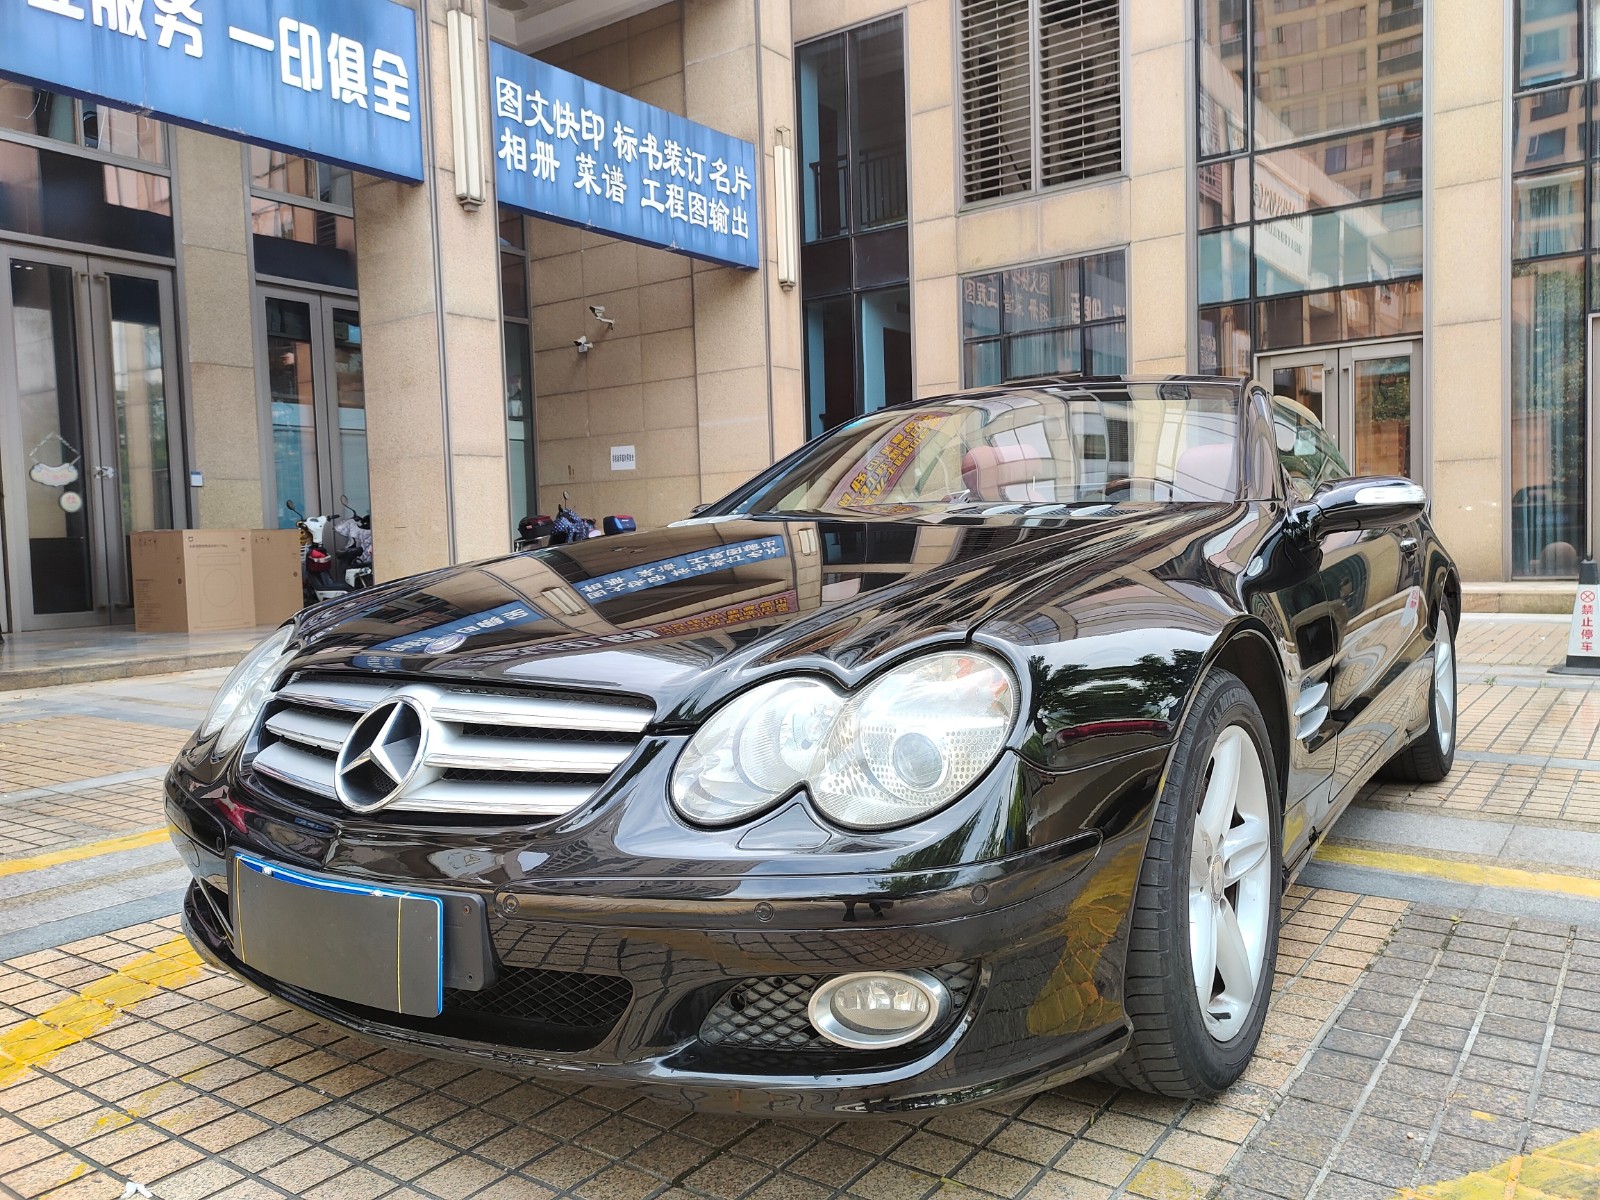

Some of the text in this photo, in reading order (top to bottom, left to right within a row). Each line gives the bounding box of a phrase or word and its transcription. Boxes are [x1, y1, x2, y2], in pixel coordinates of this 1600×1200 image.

[228, 16, 411, 122] 一印俱全
[495, 76, 752, 200] 图文快印 标书装订 名片
[498, 127, 749, 240] 相册 菜谱 工程图输出
[1581, 605, 1593, 652] 禁止停车
